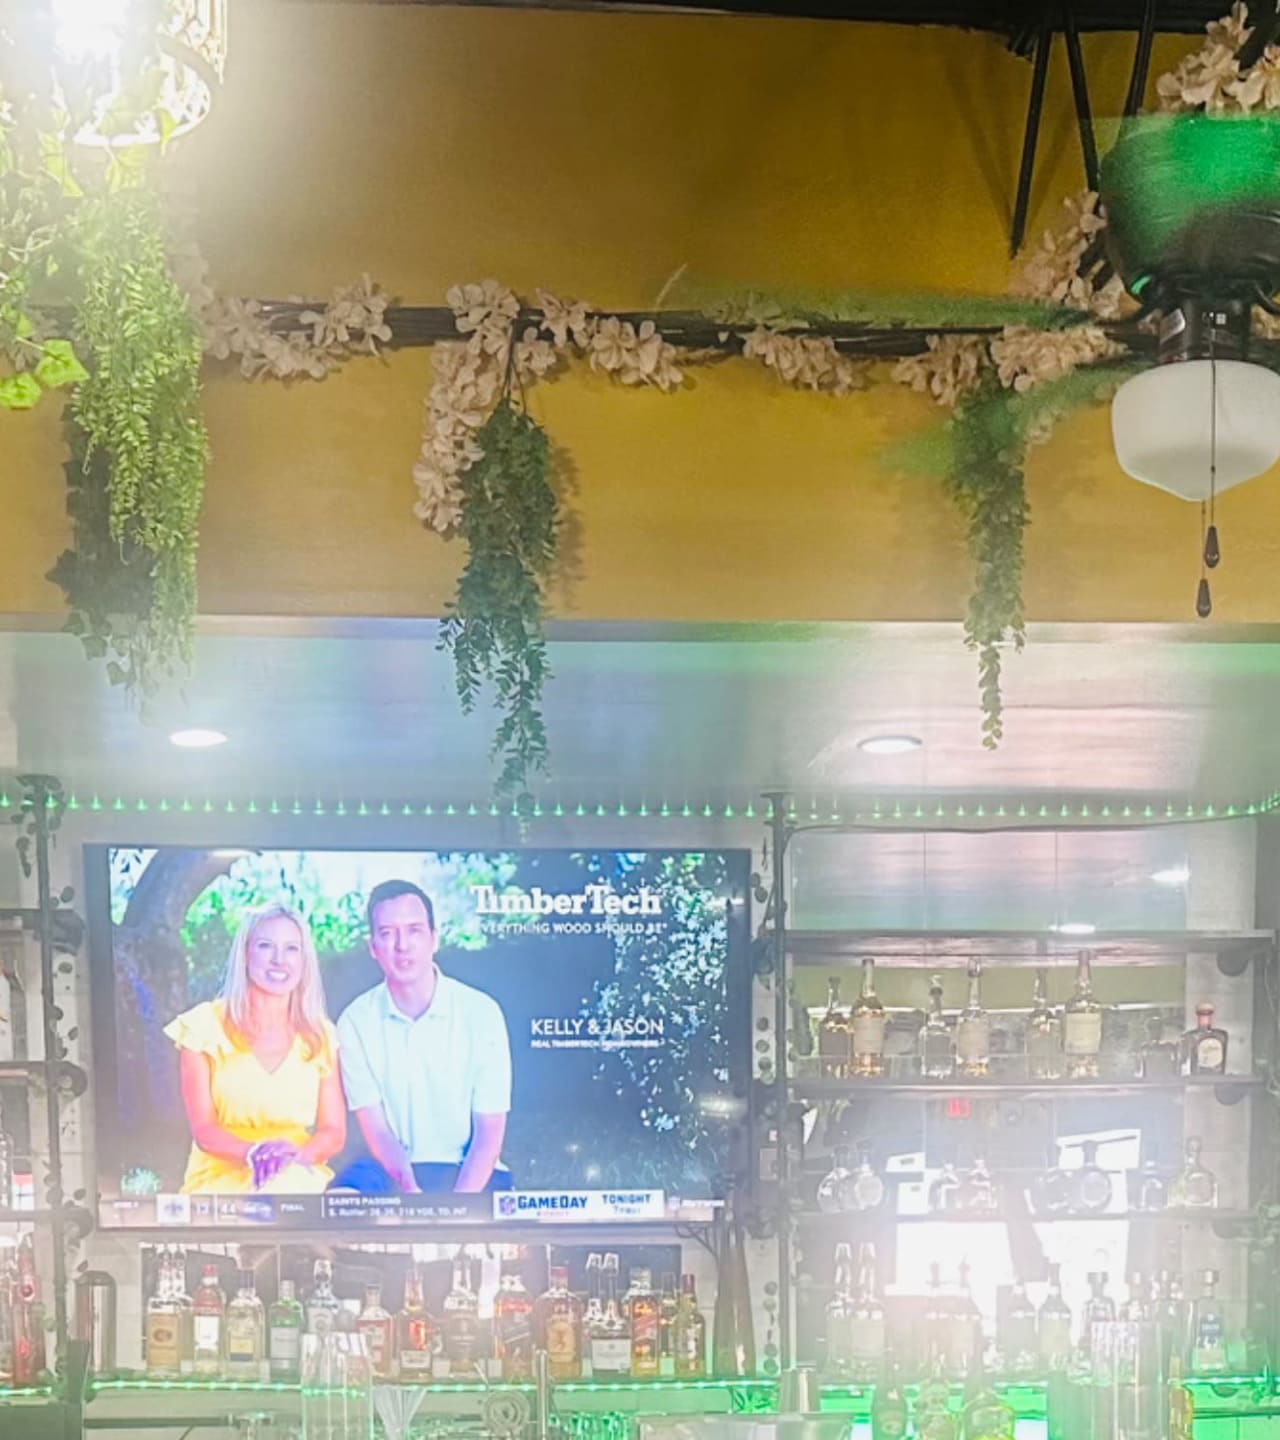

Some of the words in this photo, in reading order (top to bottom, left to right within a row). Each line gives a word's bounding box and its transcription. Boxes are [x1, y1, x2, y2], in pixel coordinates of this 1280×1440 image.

[470, 885, 662, 915] TimberTech
[477, 923, 550, 934] VERYTHNG
[552, 923, 591, 934] WOOD
[595, 923, 644, 934] SHOULD
[531, 1018, 584, 1035] KELLY
[588, 1018, 600, 1035] &
[603, 1018, 664, 1035] JASON
[602, 1194, 651, 1204] TONIGHT
